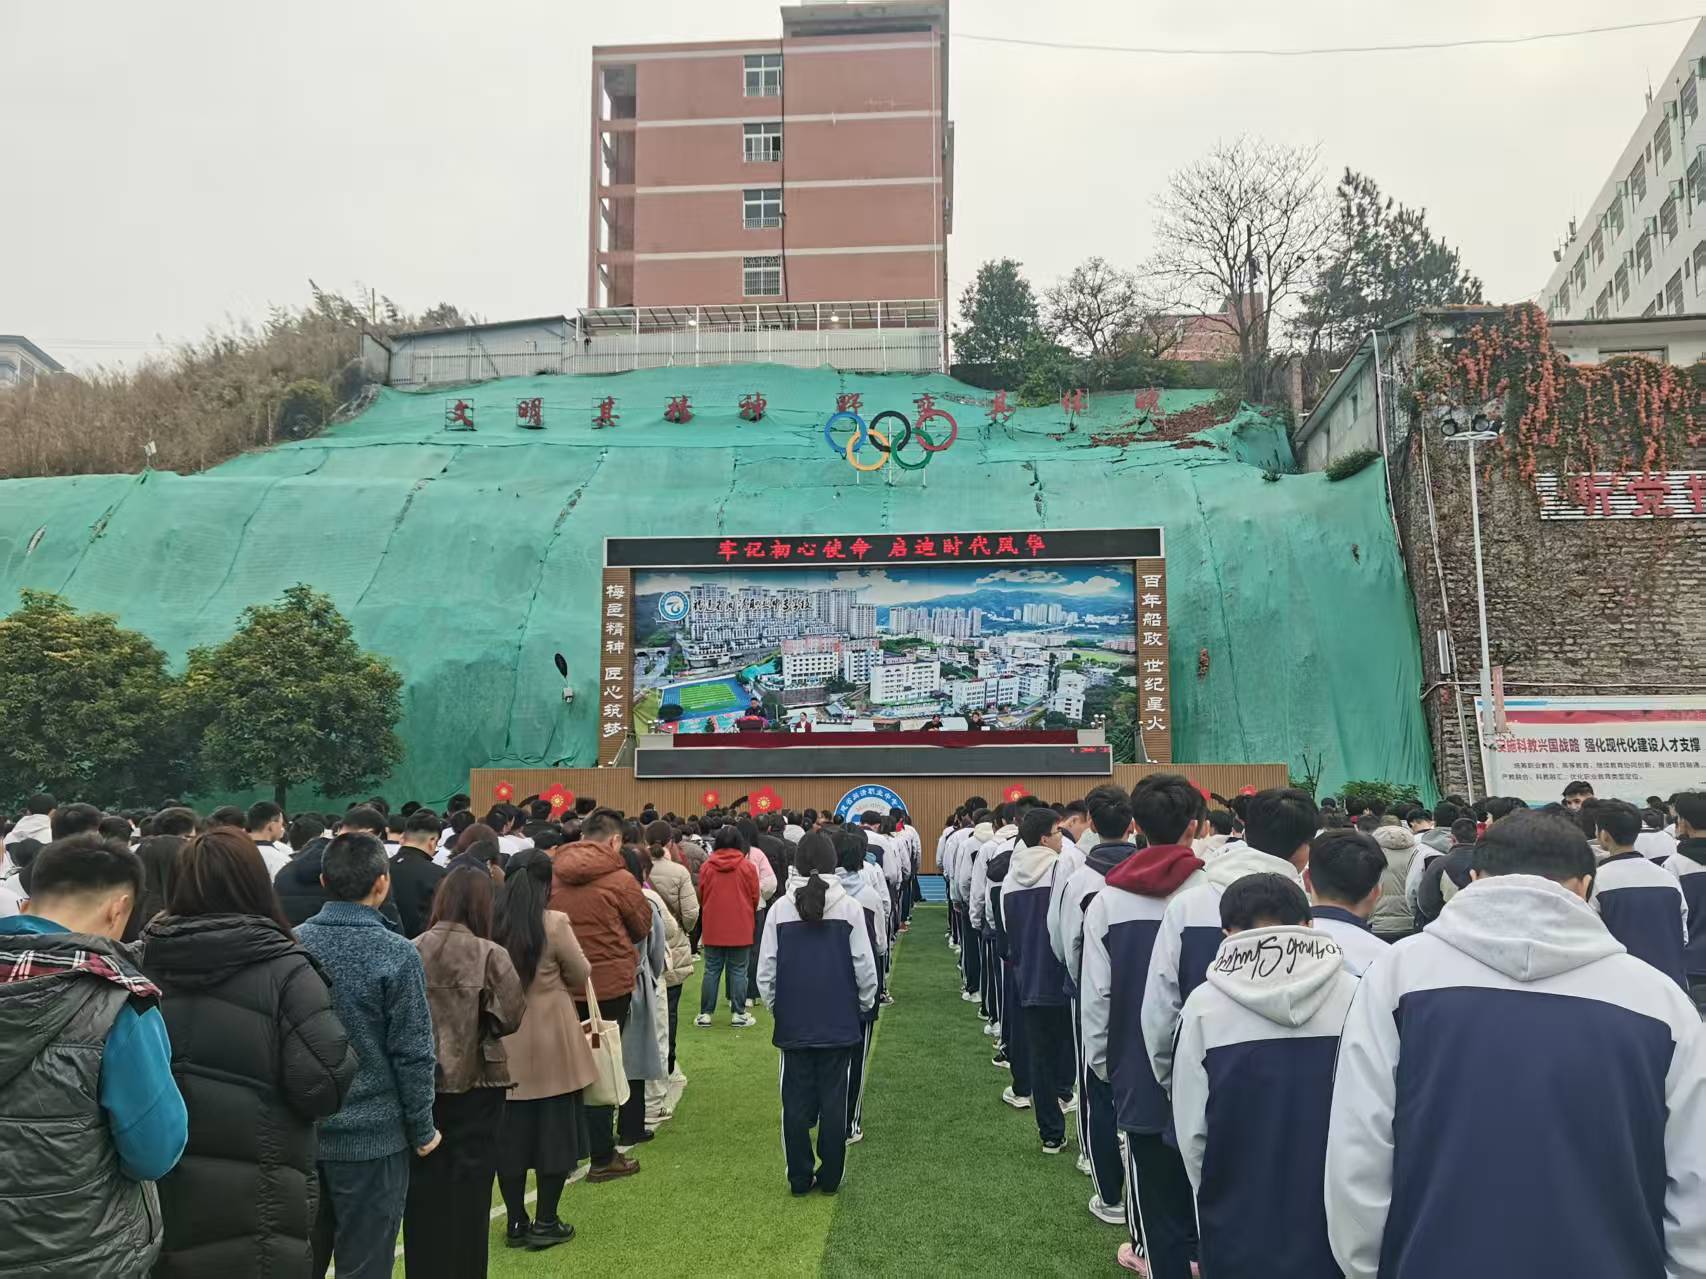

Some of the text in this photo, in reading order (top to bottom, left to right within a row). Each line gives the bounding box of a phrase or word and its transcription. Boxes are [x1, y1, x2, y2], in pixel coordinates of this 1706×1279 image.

[717, 533, 1046, 562] 牢记初心使命 启迪时代风华
[602, 584, 625, 738] 梅邑精神 匠心筑梦
[1141, 574, 1166, 731] 百年船政 世纪星火
[1584, 736, 1701, 753] 强化现代化建设人才支撑
